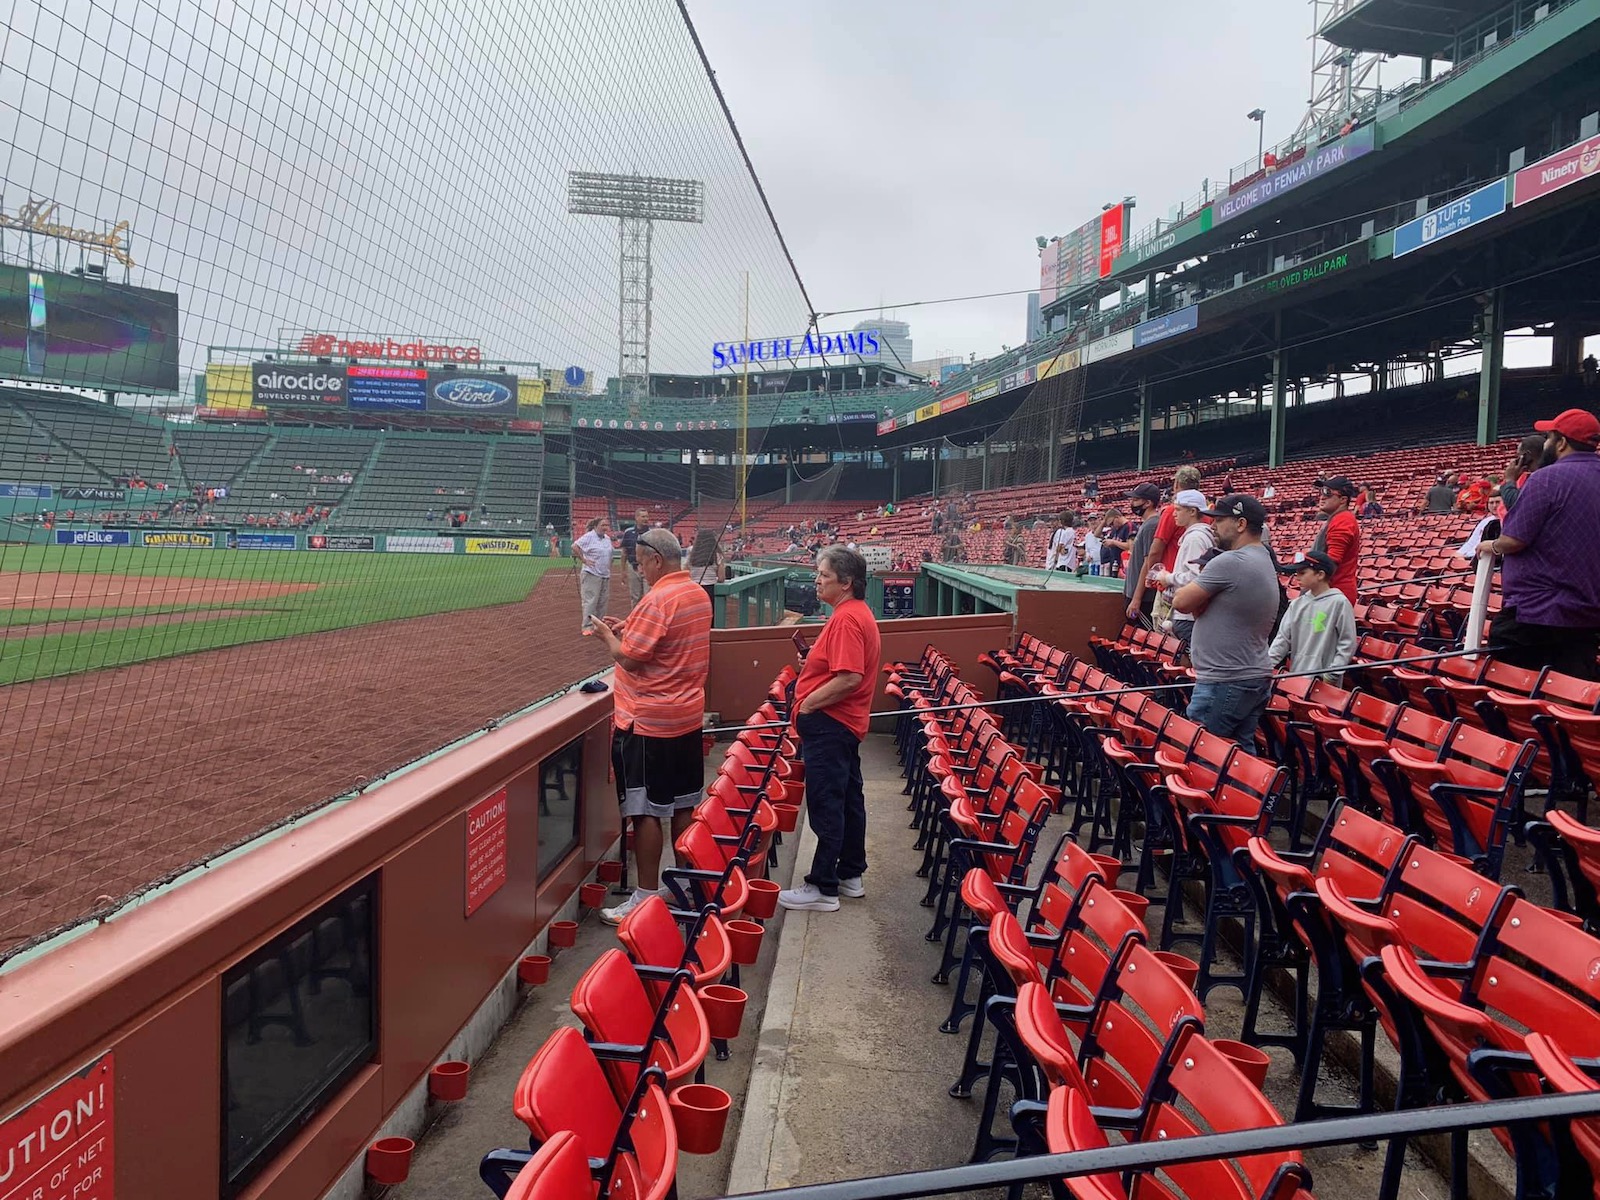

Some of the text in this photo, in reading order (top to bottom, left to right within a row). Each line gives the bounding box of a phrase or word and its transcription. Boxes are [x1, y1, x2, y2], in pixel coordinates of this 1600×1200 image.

[1220, 143, 1346, 218] WELCOME TO FENWAY PARK
[1540, 159, 1579, 185] Ninety
[1437, 199, 1472, 225] TUFTS
[1105, 225, 1118, 245] JBL
[1436, 215, 1471, 236] Health Plan
[1303, 254, 1348, 281] BALLPARK
[712, 329, 881, 370] SAMUEL ADAMS
[258, 371, 342, 391] airocide
[449, 382, 496, 403] Ford
[258, 393, 307, 401] DEVELOPED
[95, 490, 124, 499] NESN
[73, 531, 113, 544] jetBlue
[145, 533, 212, 545] GRANITE CITY
[477, 540, 519, 551] TWISTED TEA
[469, 800, 506, 835] CAUTION!
[469, 845, 478, 859] STAY
[479, 835, 492, 851] CLEAR
[498, 826, 506, 837] NET
[469, 862, 478, 871] AND
[485, 846, 496, 860] ALERT
[496, 839, 504, 850] FOR
[469, 864, 504, 898] THE PLAYING FIELD
[470, 852, 504, 885] OBJECTS LEAVING
[50, 1163, 72, 1190] OF
[78, 1137, 105, 1169] NET
[73, 1166, 102, 1200] FOR
